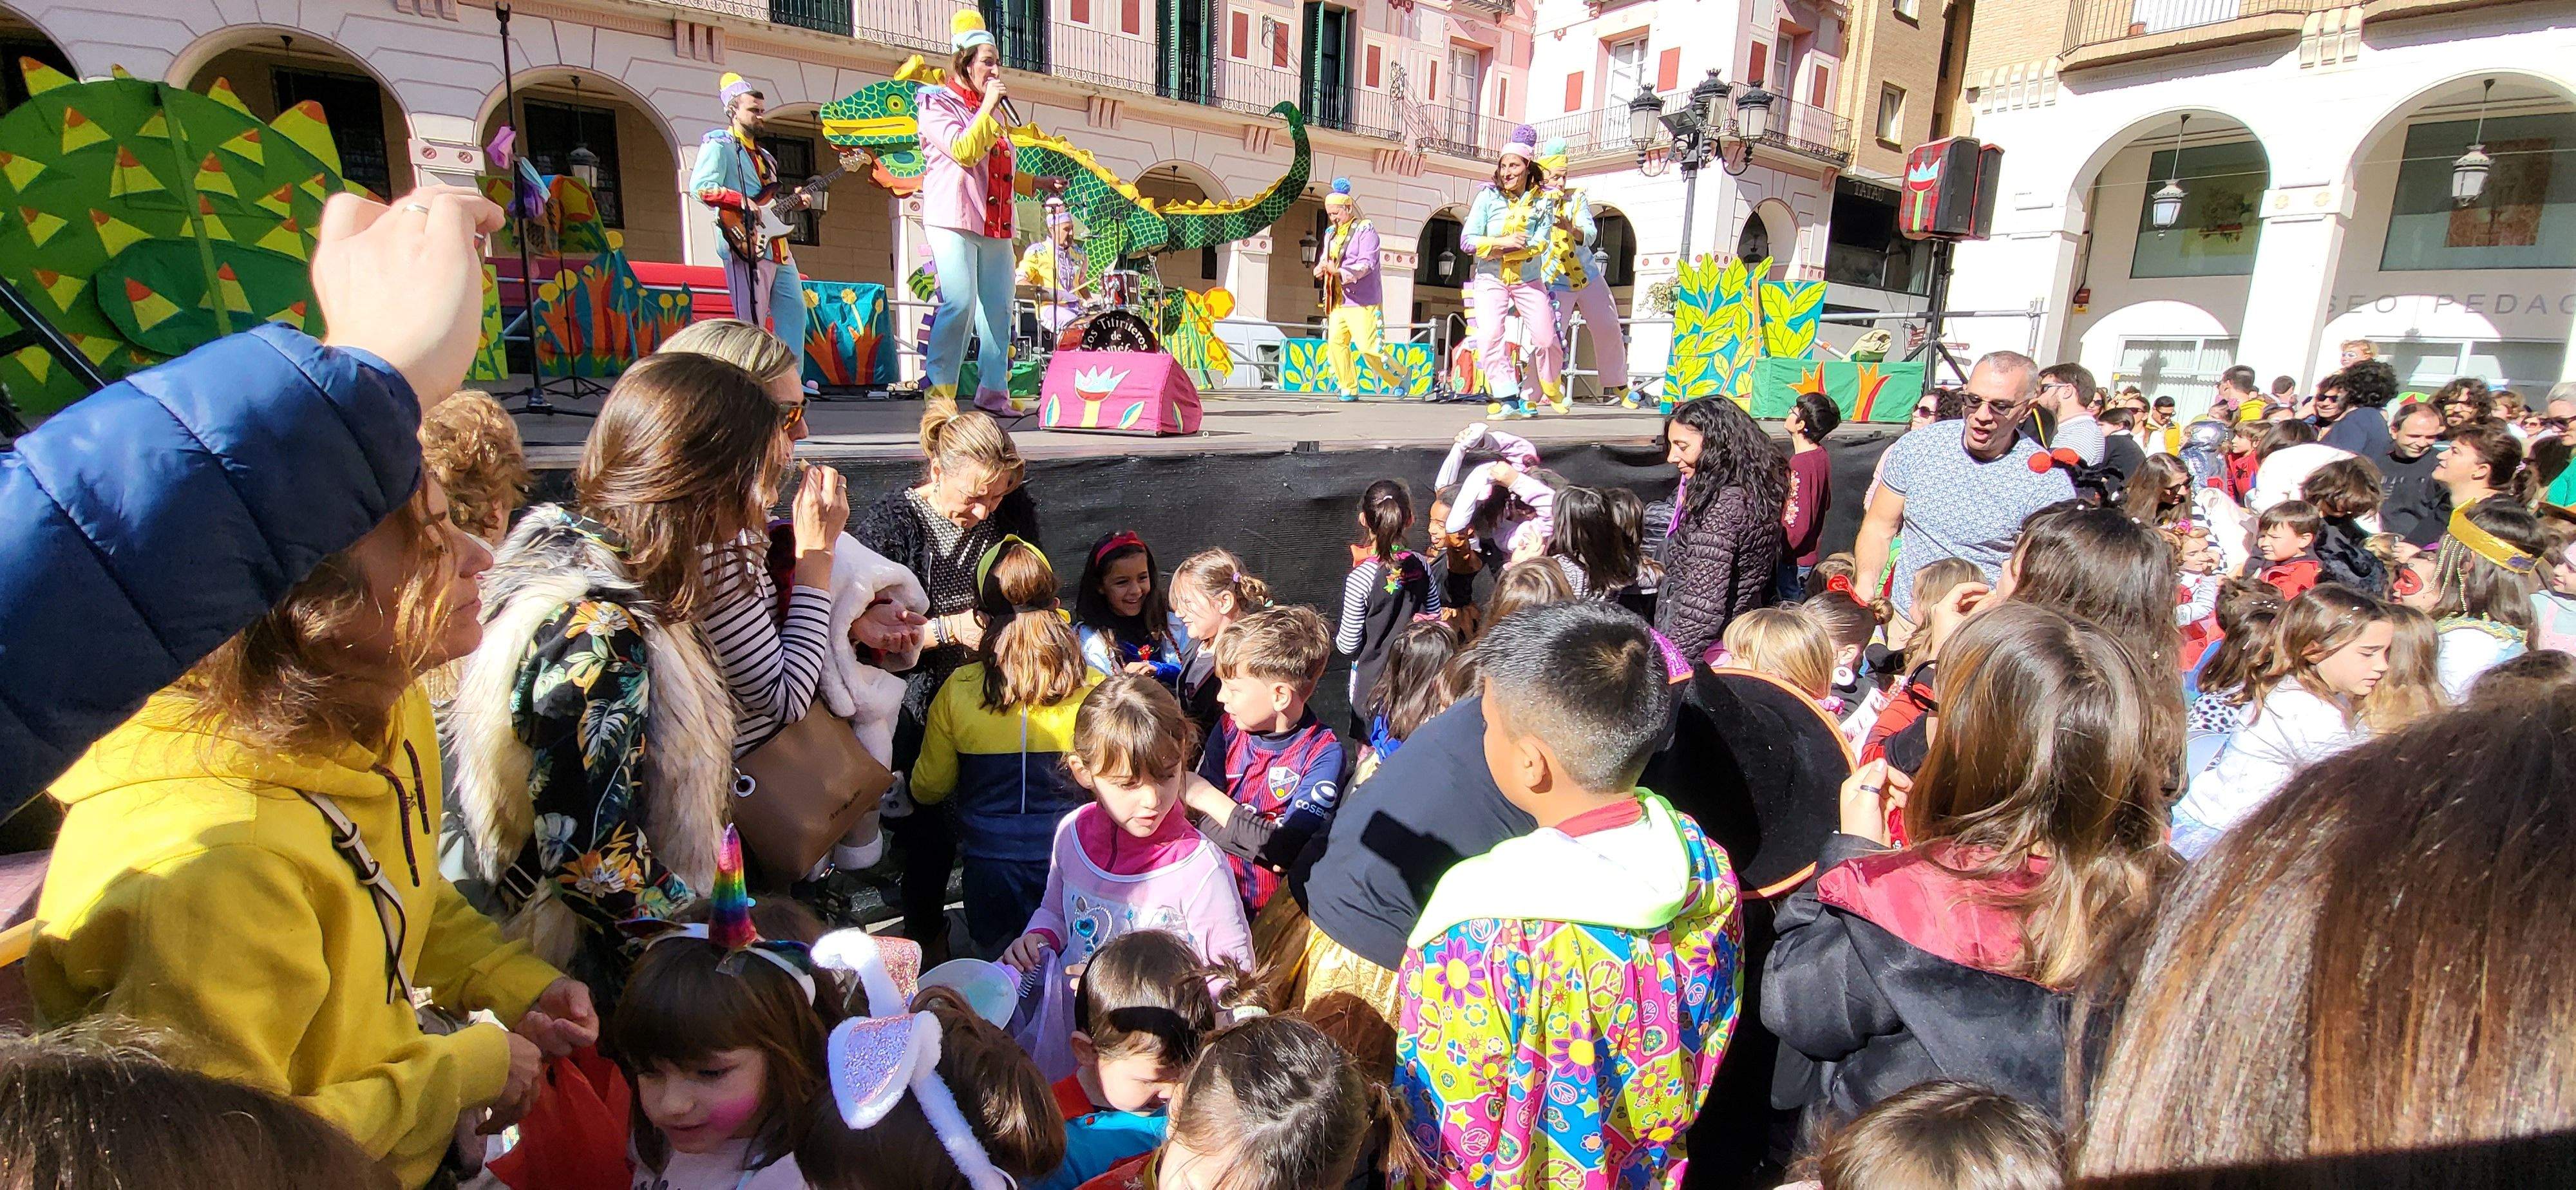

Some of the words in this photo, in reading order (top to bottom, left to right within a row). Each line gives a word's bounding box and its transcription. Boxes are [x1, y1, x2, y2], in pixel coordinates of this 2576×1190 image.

[1082, 330, 1098, 350] Los
[1097, 316, 1148, 351] Titiriteros
[1110, 330, 1122, 340] de
